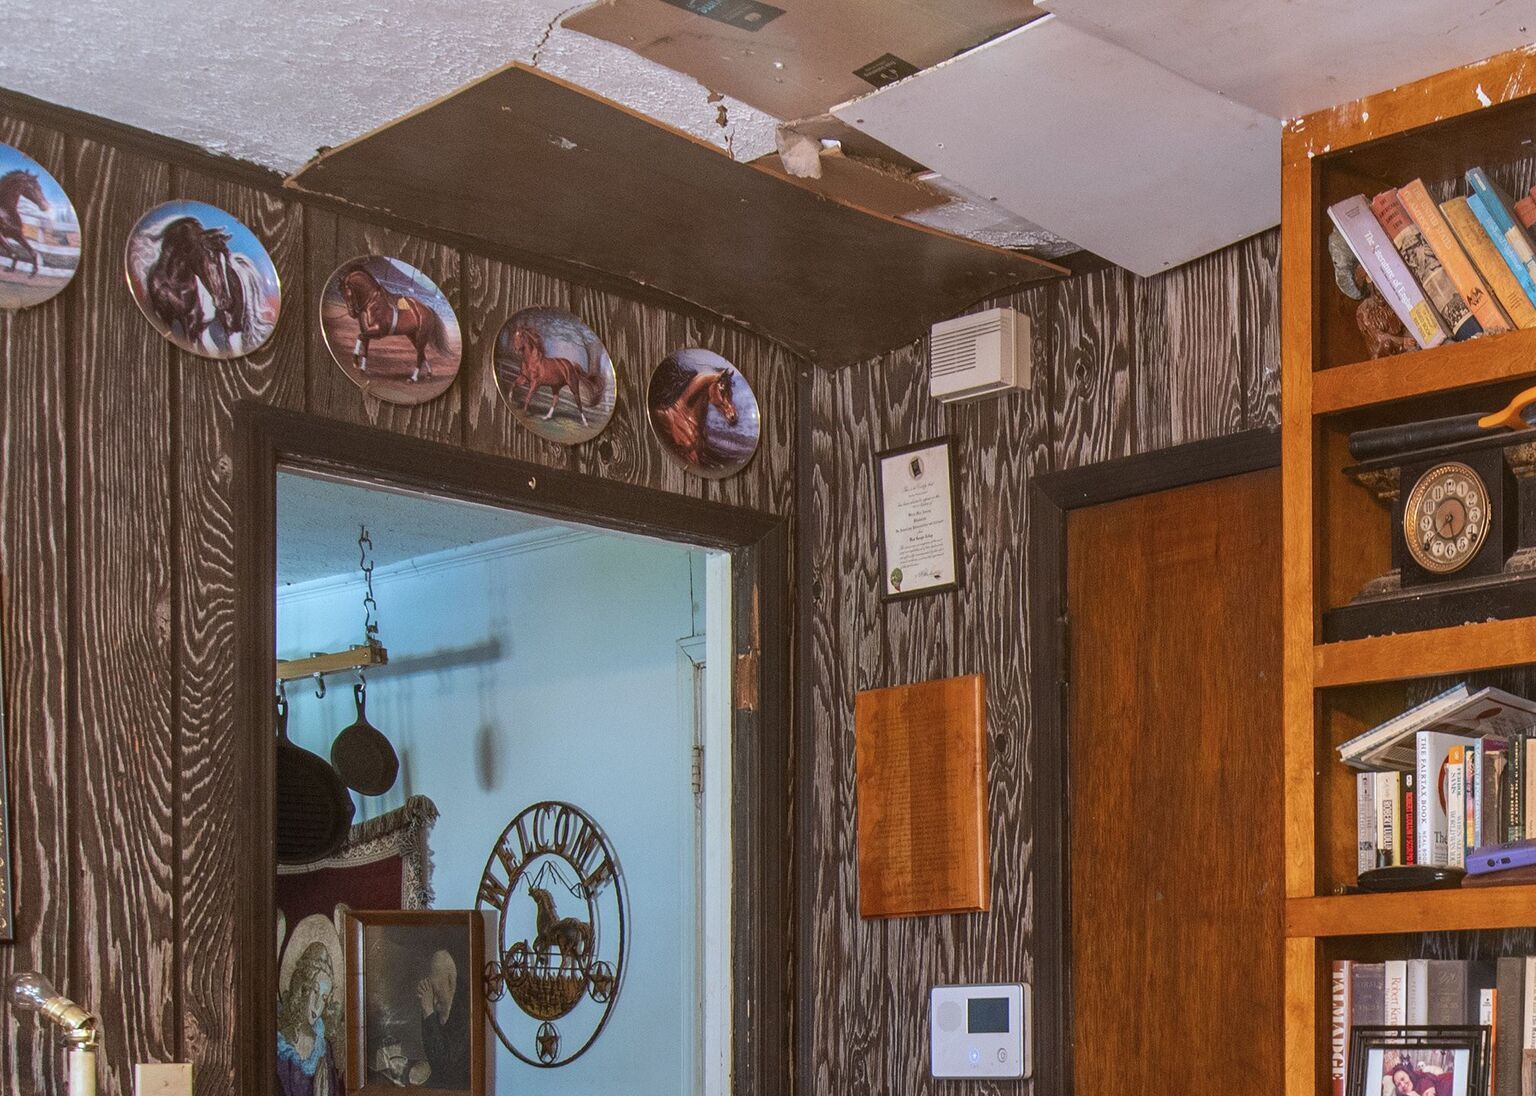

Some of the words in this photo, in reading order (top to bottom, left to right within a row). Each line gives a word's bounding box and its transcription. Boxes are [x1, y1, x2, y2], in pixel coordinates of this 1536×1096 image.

[1363, 230, 1377, 247] The
[479, 804, 617, 911] WELCOME
[1332, 969, 1345, 1080] TALMADGE
[1391, 977, 1401, 1005] Robert
